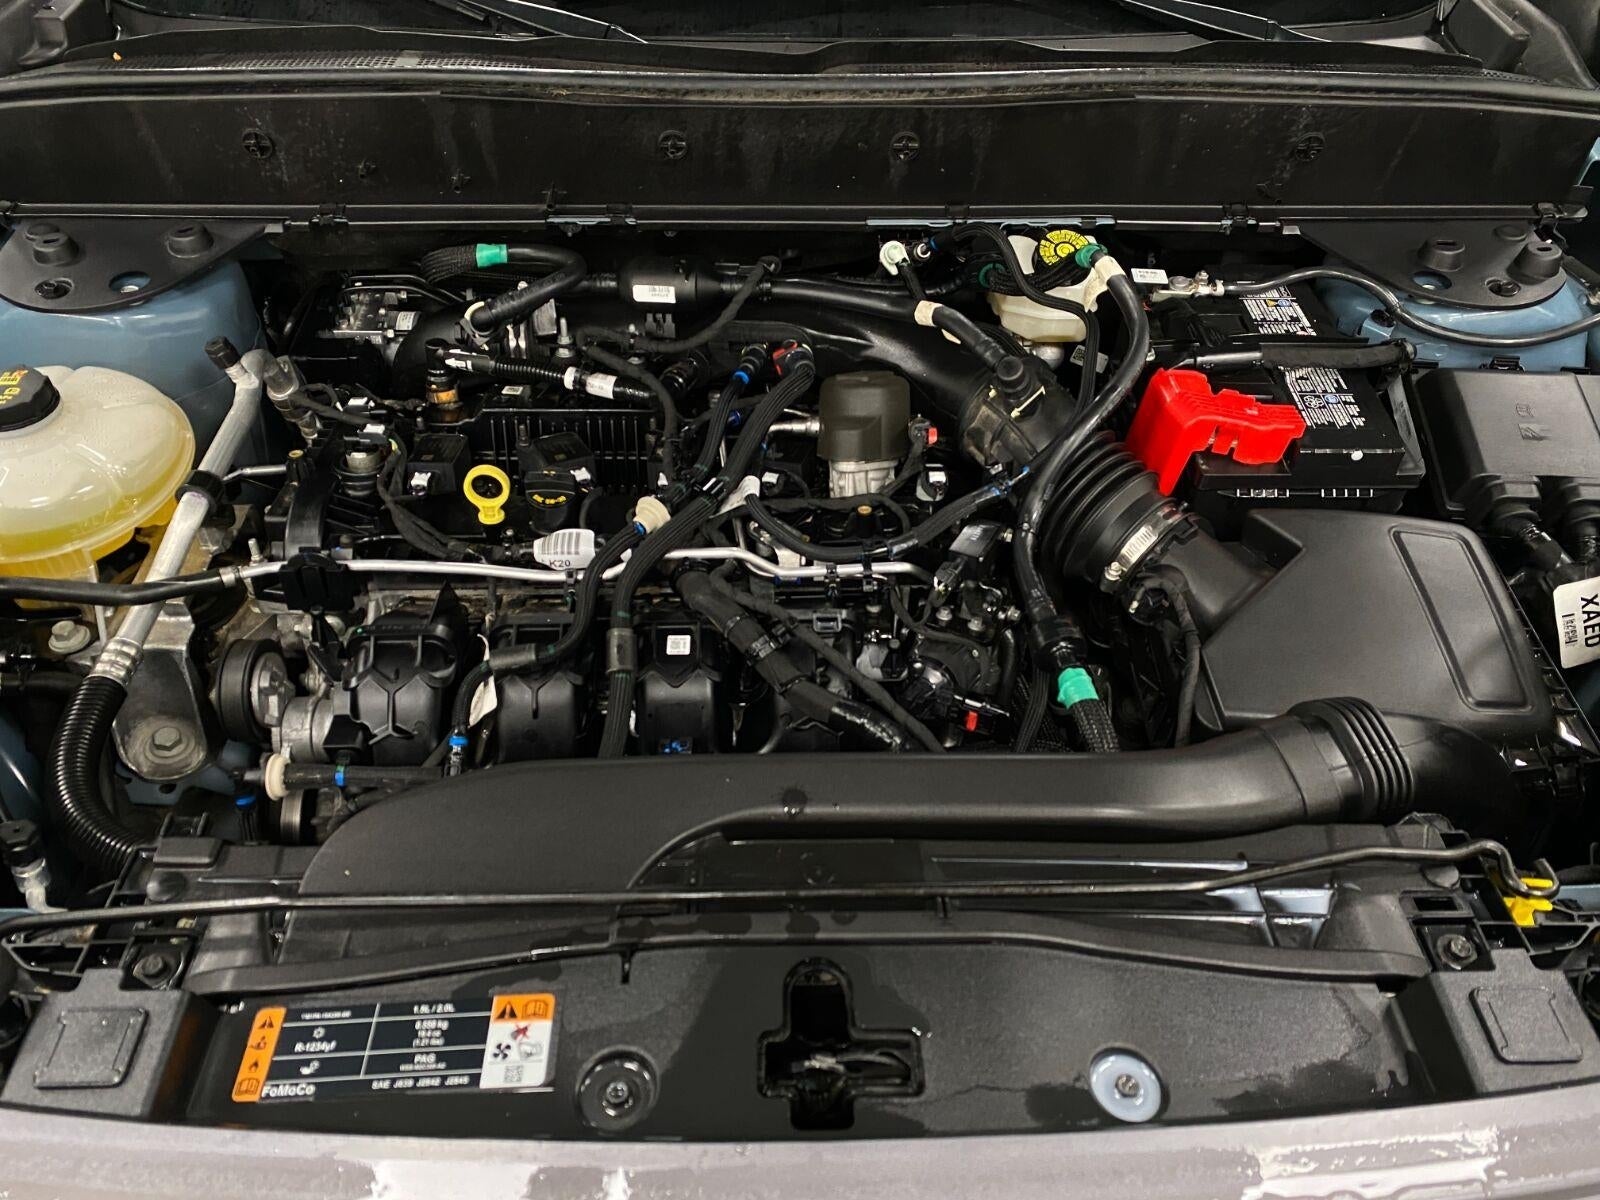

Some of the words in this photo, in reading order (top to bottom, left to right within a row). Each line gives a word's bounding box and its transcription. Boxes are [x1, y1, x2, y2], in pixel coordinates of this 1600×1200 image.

[549, 559, 571, 568] K20
[1580, 593, 1600, 648] XAED
[294, 1039, 337, 1053] R-1234yf
[414, 1053, 436, 1063] PAG
[261, 1083, 316, 1097] FoMoCo
[372, 1079, 391, 1089] SAE
